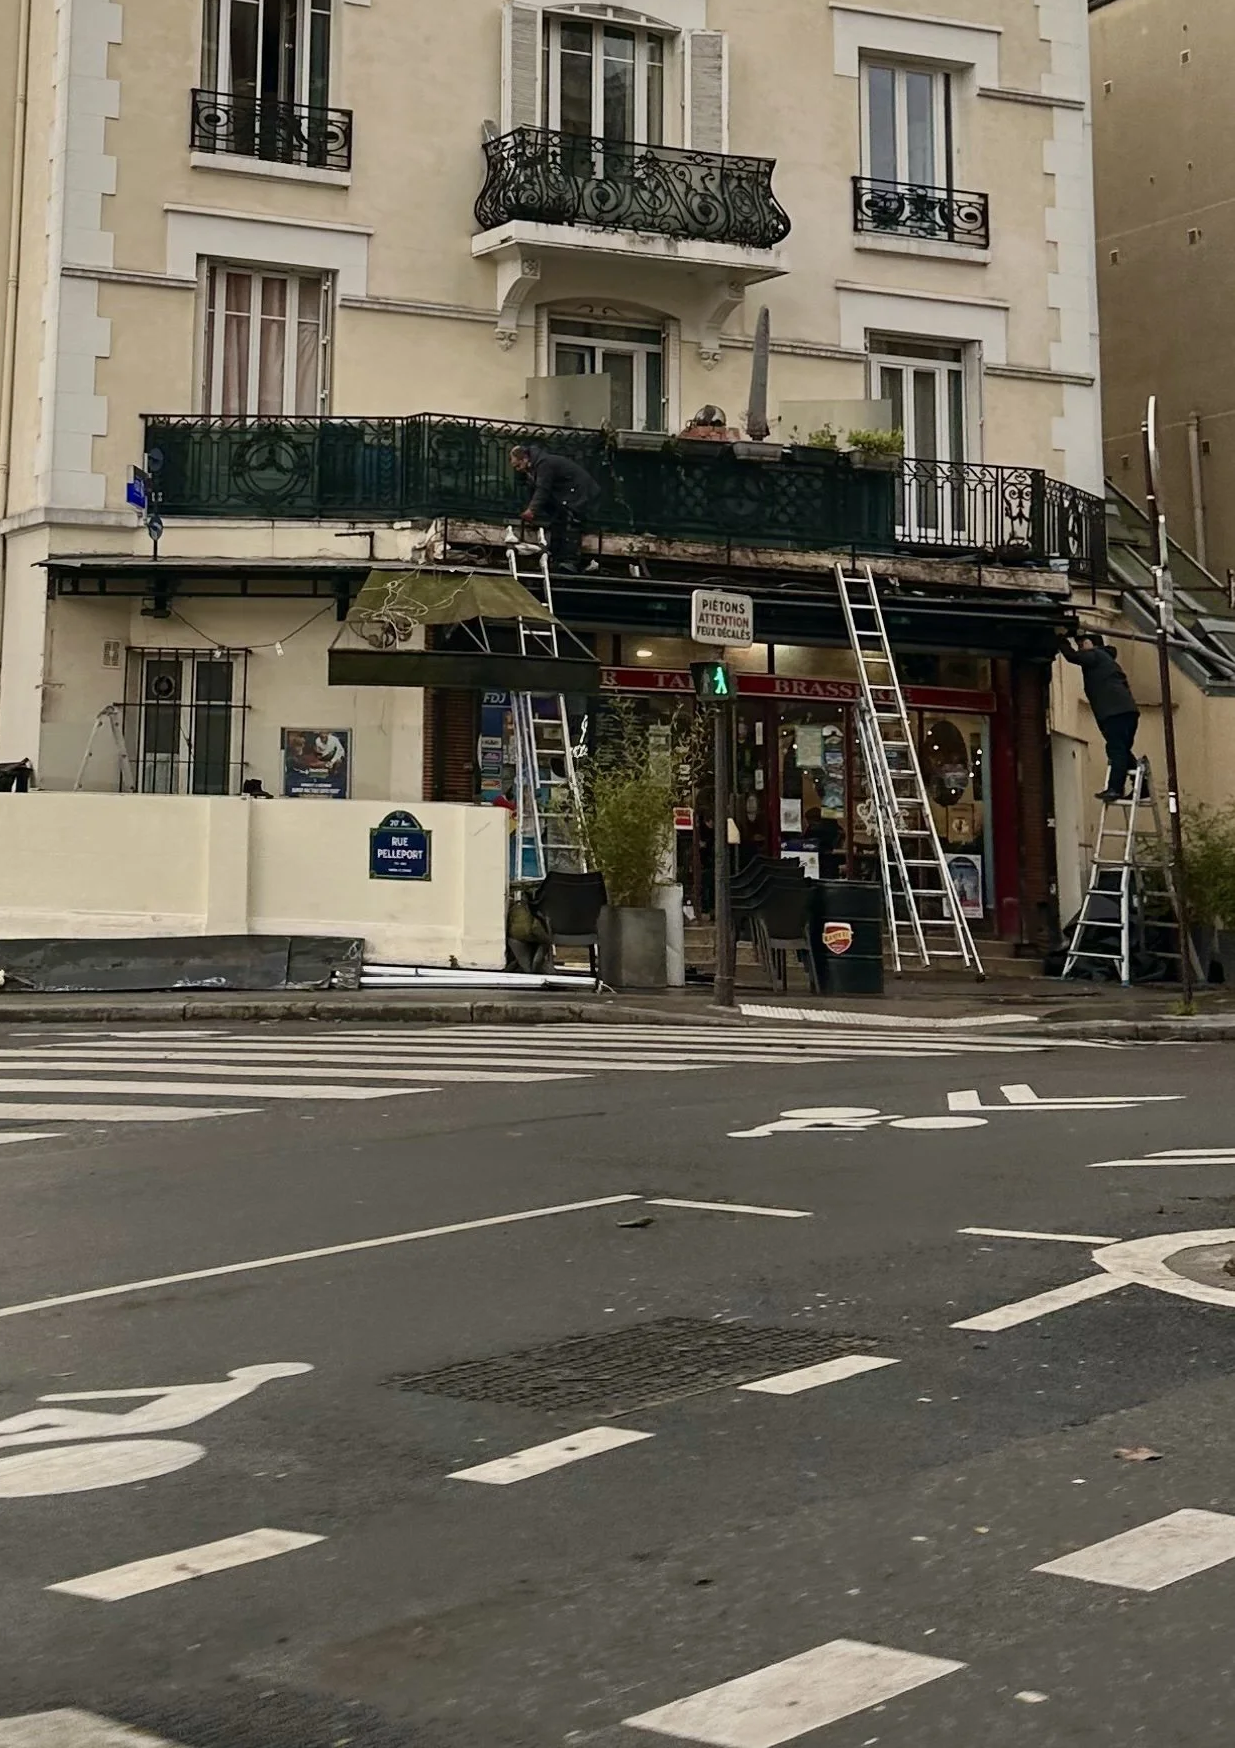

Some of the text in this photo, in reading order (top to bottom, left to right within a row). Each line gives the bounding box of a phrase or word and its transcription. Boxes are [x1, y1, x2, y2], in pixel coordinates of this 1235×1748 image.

[702, 598, 745, 614] PIÉTONS
[698, 612, 749, 628] ATTENTION
[696, 625, 751, 641] FEUX DÉCALÉS
[483, 692, 506, 704] FDJ
[391, 836, 409, 847] RUE
[377, 848, 424, 860] PELLEPORT
